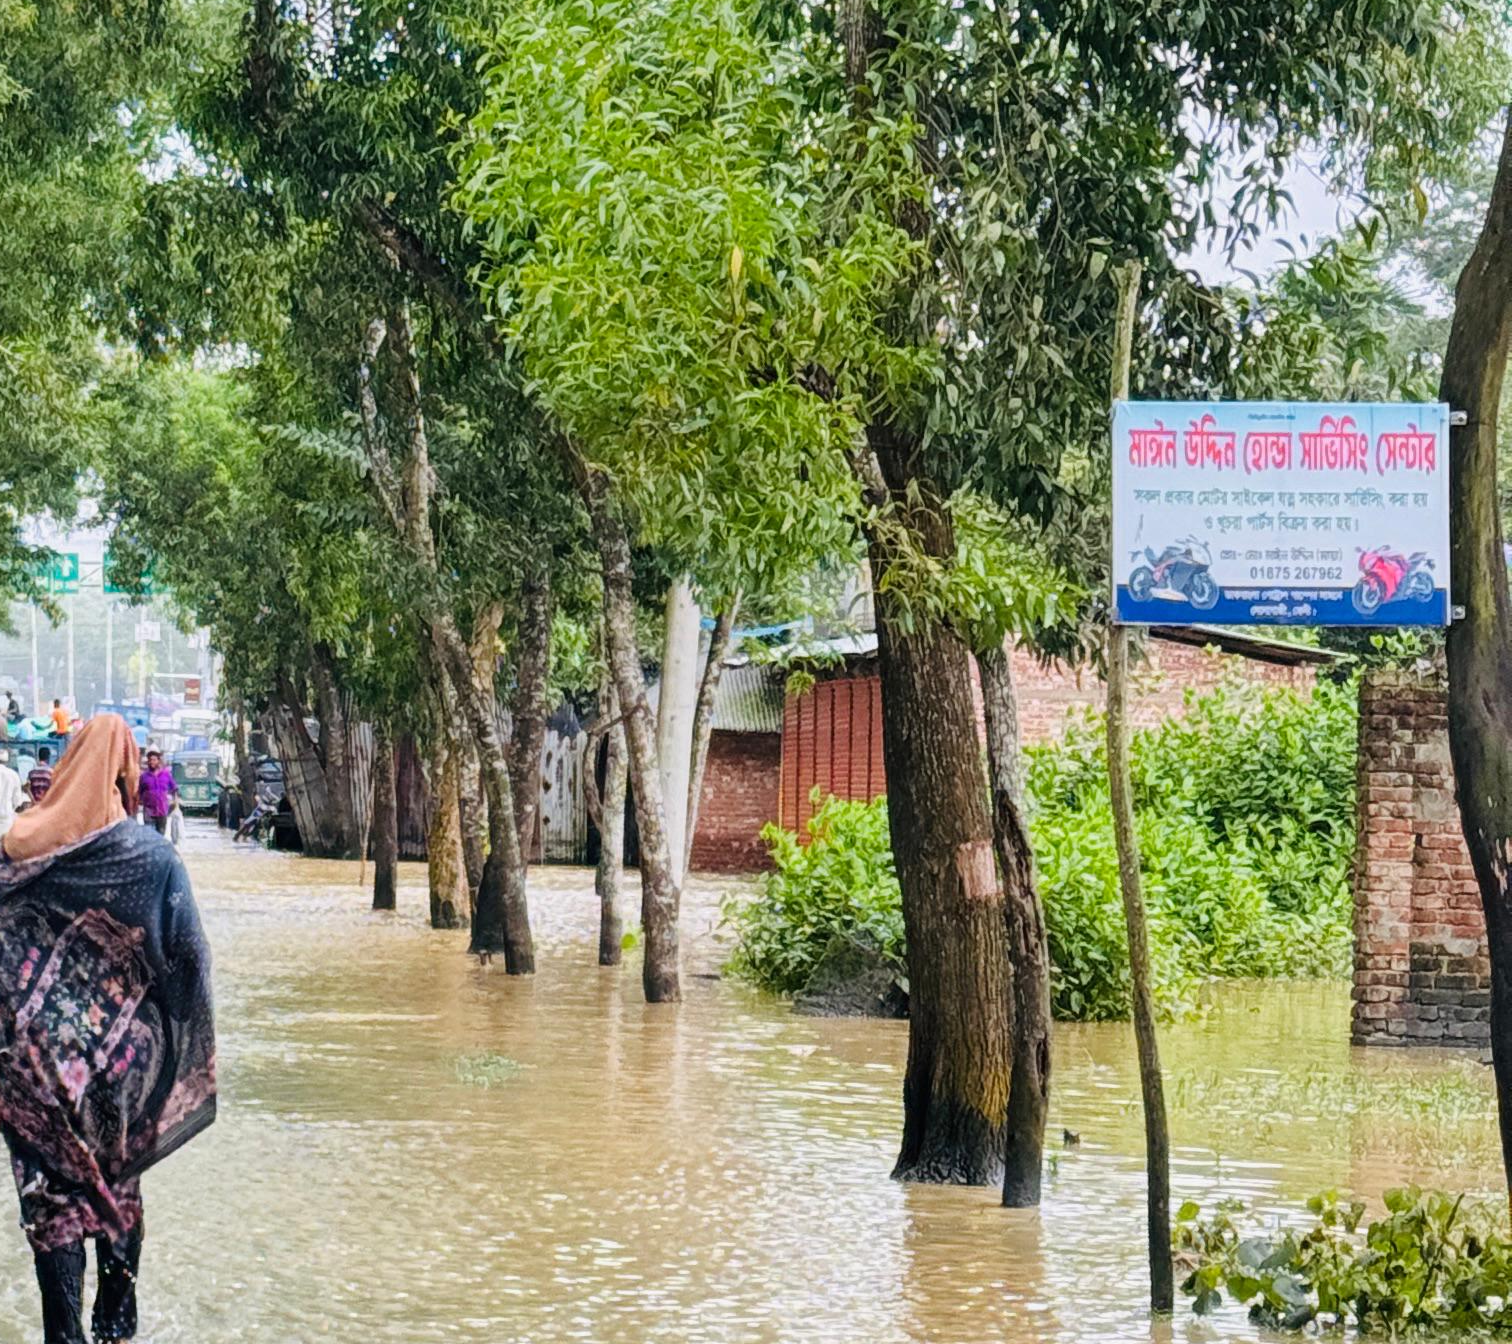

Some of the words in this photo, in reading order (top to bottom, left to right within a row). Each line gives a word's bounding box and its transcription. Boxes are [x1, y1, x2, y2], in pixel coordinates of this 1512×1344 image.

[1183, 413, 1237, 471] উদ্দিন
[1243, 432, 1292, 475] হোন্ডা
[1299, 414, 1369, 475] সার্ভিসিং
[1376, 422, 1437, 476] সেন্টার
[1133, 488, 1162, 504] সকল
[1164, 489, 1194, 505] প্রকার
[1197, 487, 1228, 506] মোটর
[1231, 487, 1275, 506] সাইকেল
[1298, 492, 1341, 507] সহকারে
[1388, 492, 1409, 507] করা
[1203, 515, 1213, 530] ও
[1217, 515, 1242, 534] খুচরা
[1311, 516, 1332, 531] করা
[1249, 566, 1291, 580] 01875
[1294, 566, 1343, 580] 267962
